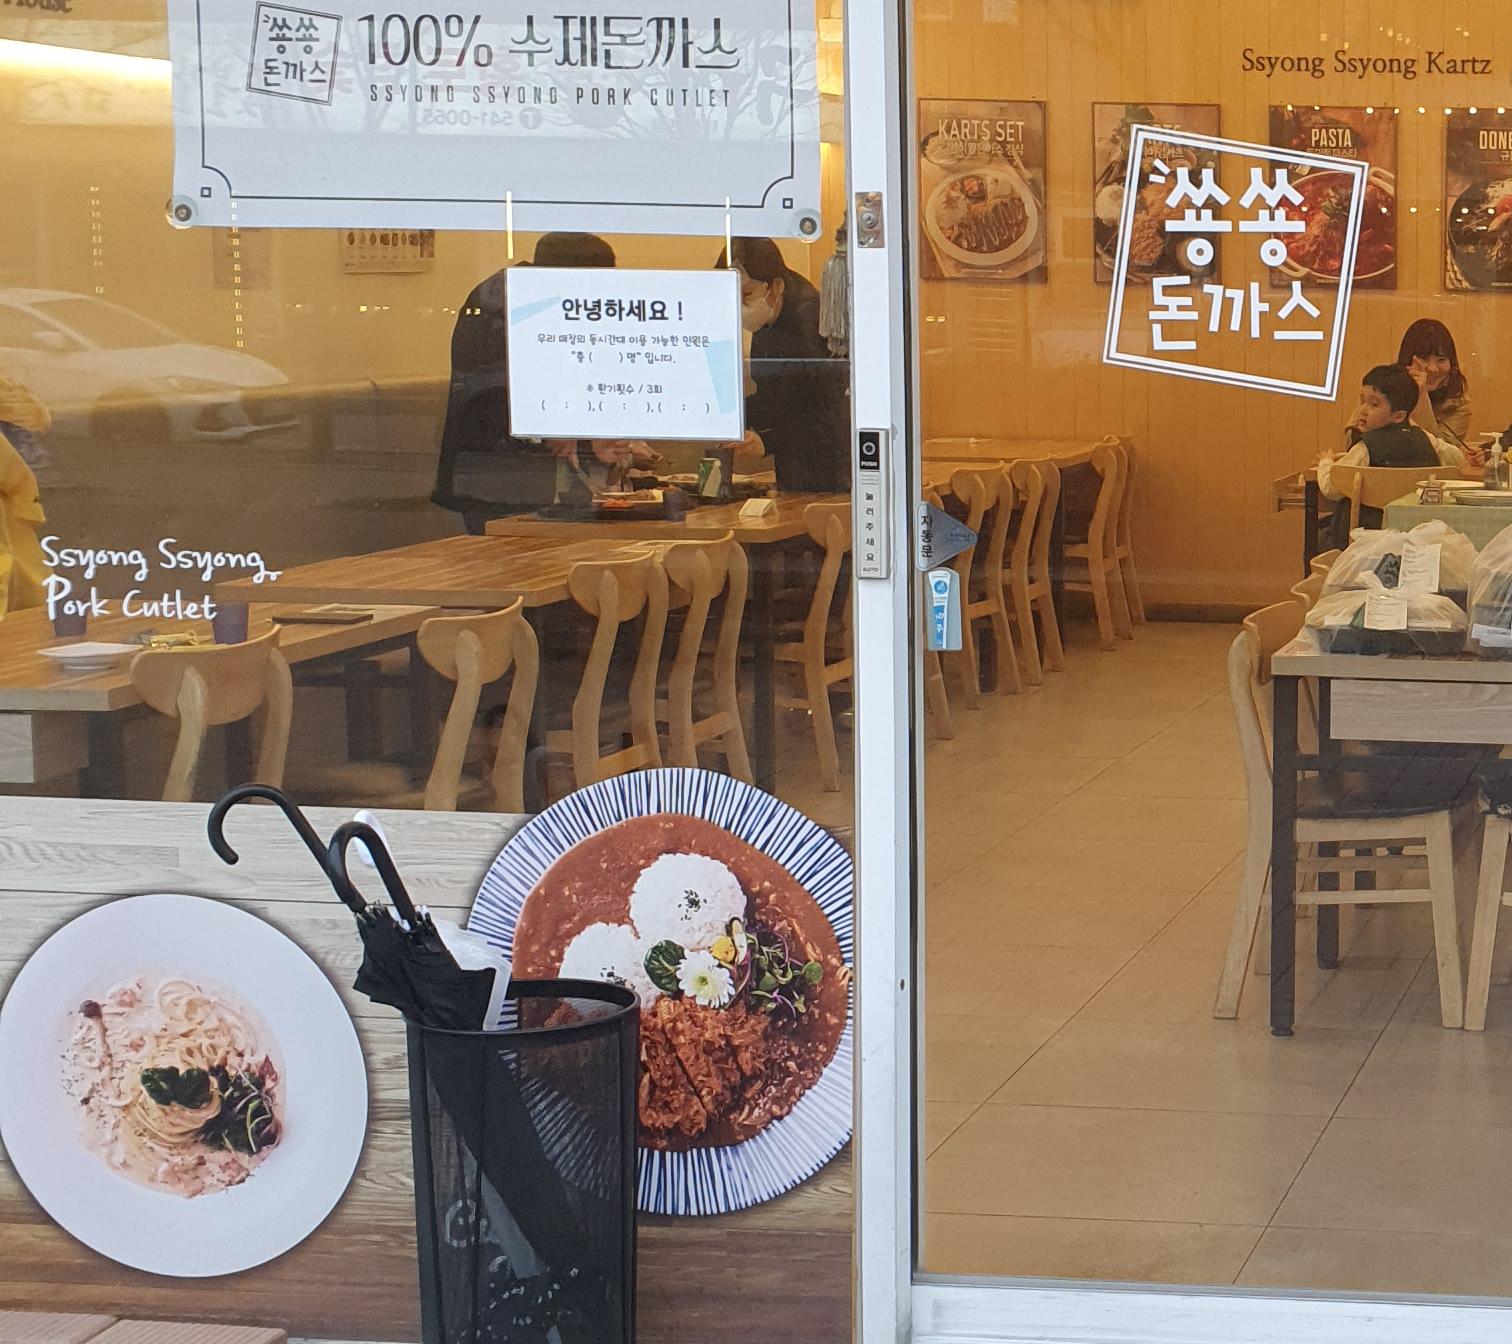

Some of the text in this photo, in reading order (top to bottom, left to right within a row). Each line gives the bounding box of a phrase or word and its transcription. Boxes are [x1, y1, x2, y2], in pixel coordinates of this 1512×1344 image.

[357, 13, 740, 70] 100% 수제돈까스
[263, 58, 327, 87] 돈까스
[1241, 48, 1492, 80] Ssyong Ssyong Kartz
[370, 84, 730, 108] SSYONG SSYONG PORK CUTLET
[938, 119, 1025, 142] KARTS SET
[1311, 128, 1352, 147] PASTA
[562, 298, 669, 322] 안녕하세요
[1149, 275, 1324, 351] 돈까스
[537, 333, 710, 347] 우리 매장의 동시간대 이용 가능한 인원은
[645, 353, 676, 364] 입니다.
[40, 535, 149, 582] Ssyong
[42, 573, 217, 620] Pork Cutlet
